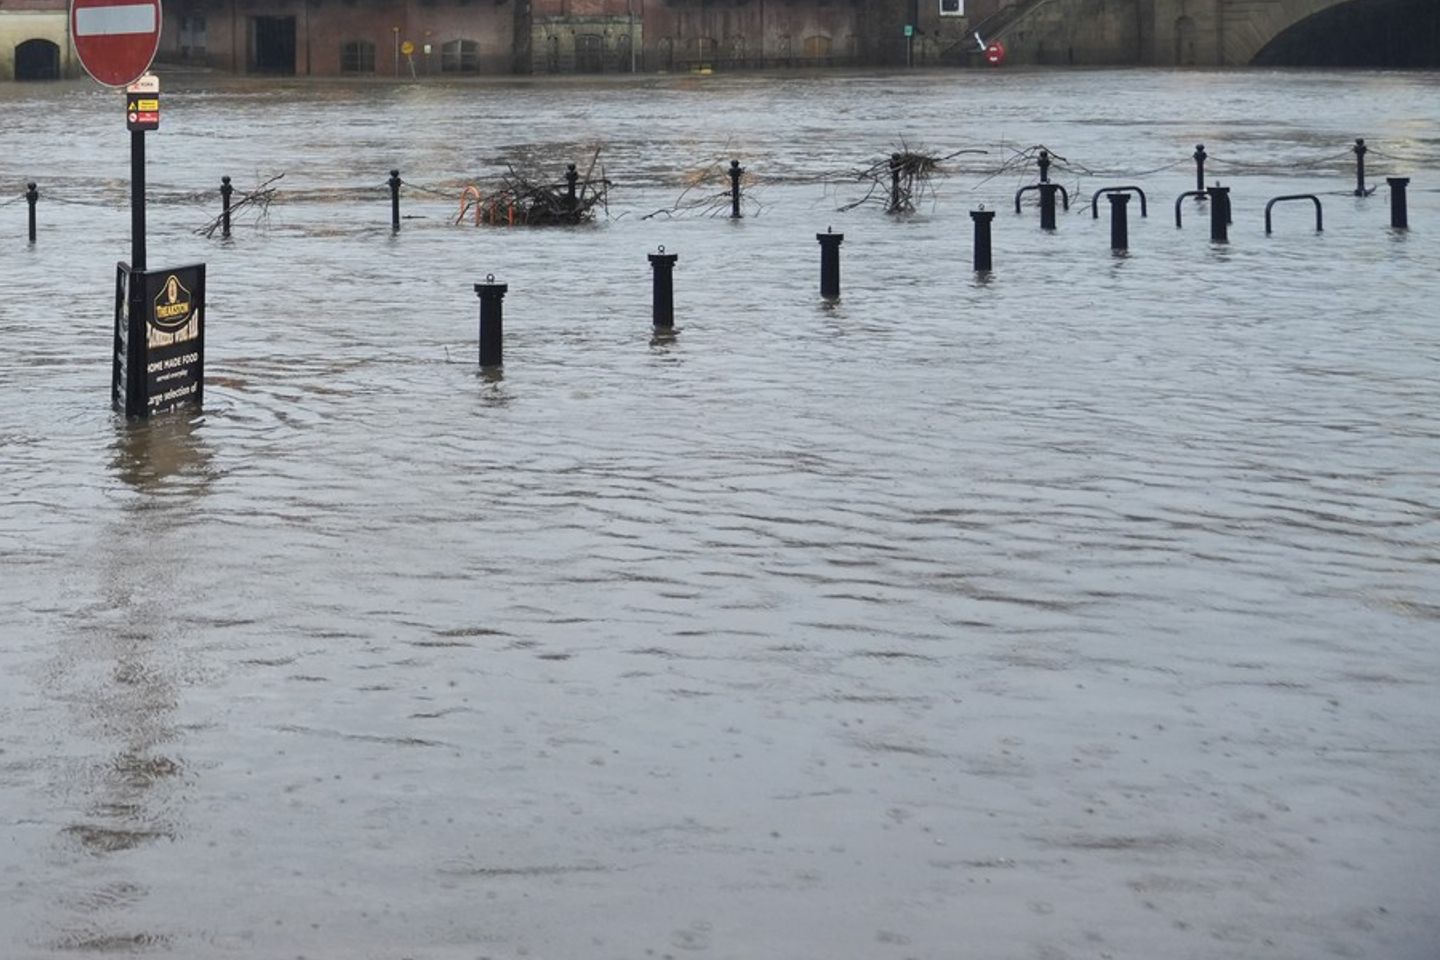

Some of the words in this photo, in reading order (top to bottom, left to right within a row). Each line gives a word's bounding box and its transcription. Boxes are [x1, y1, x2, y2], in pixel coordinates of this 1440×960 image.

[163, 356, 182, 369] MADE
[182, 352, 198, 364] FOOD
[164, 385, 190, 400] selection
[190, 381, 198, 393] of
